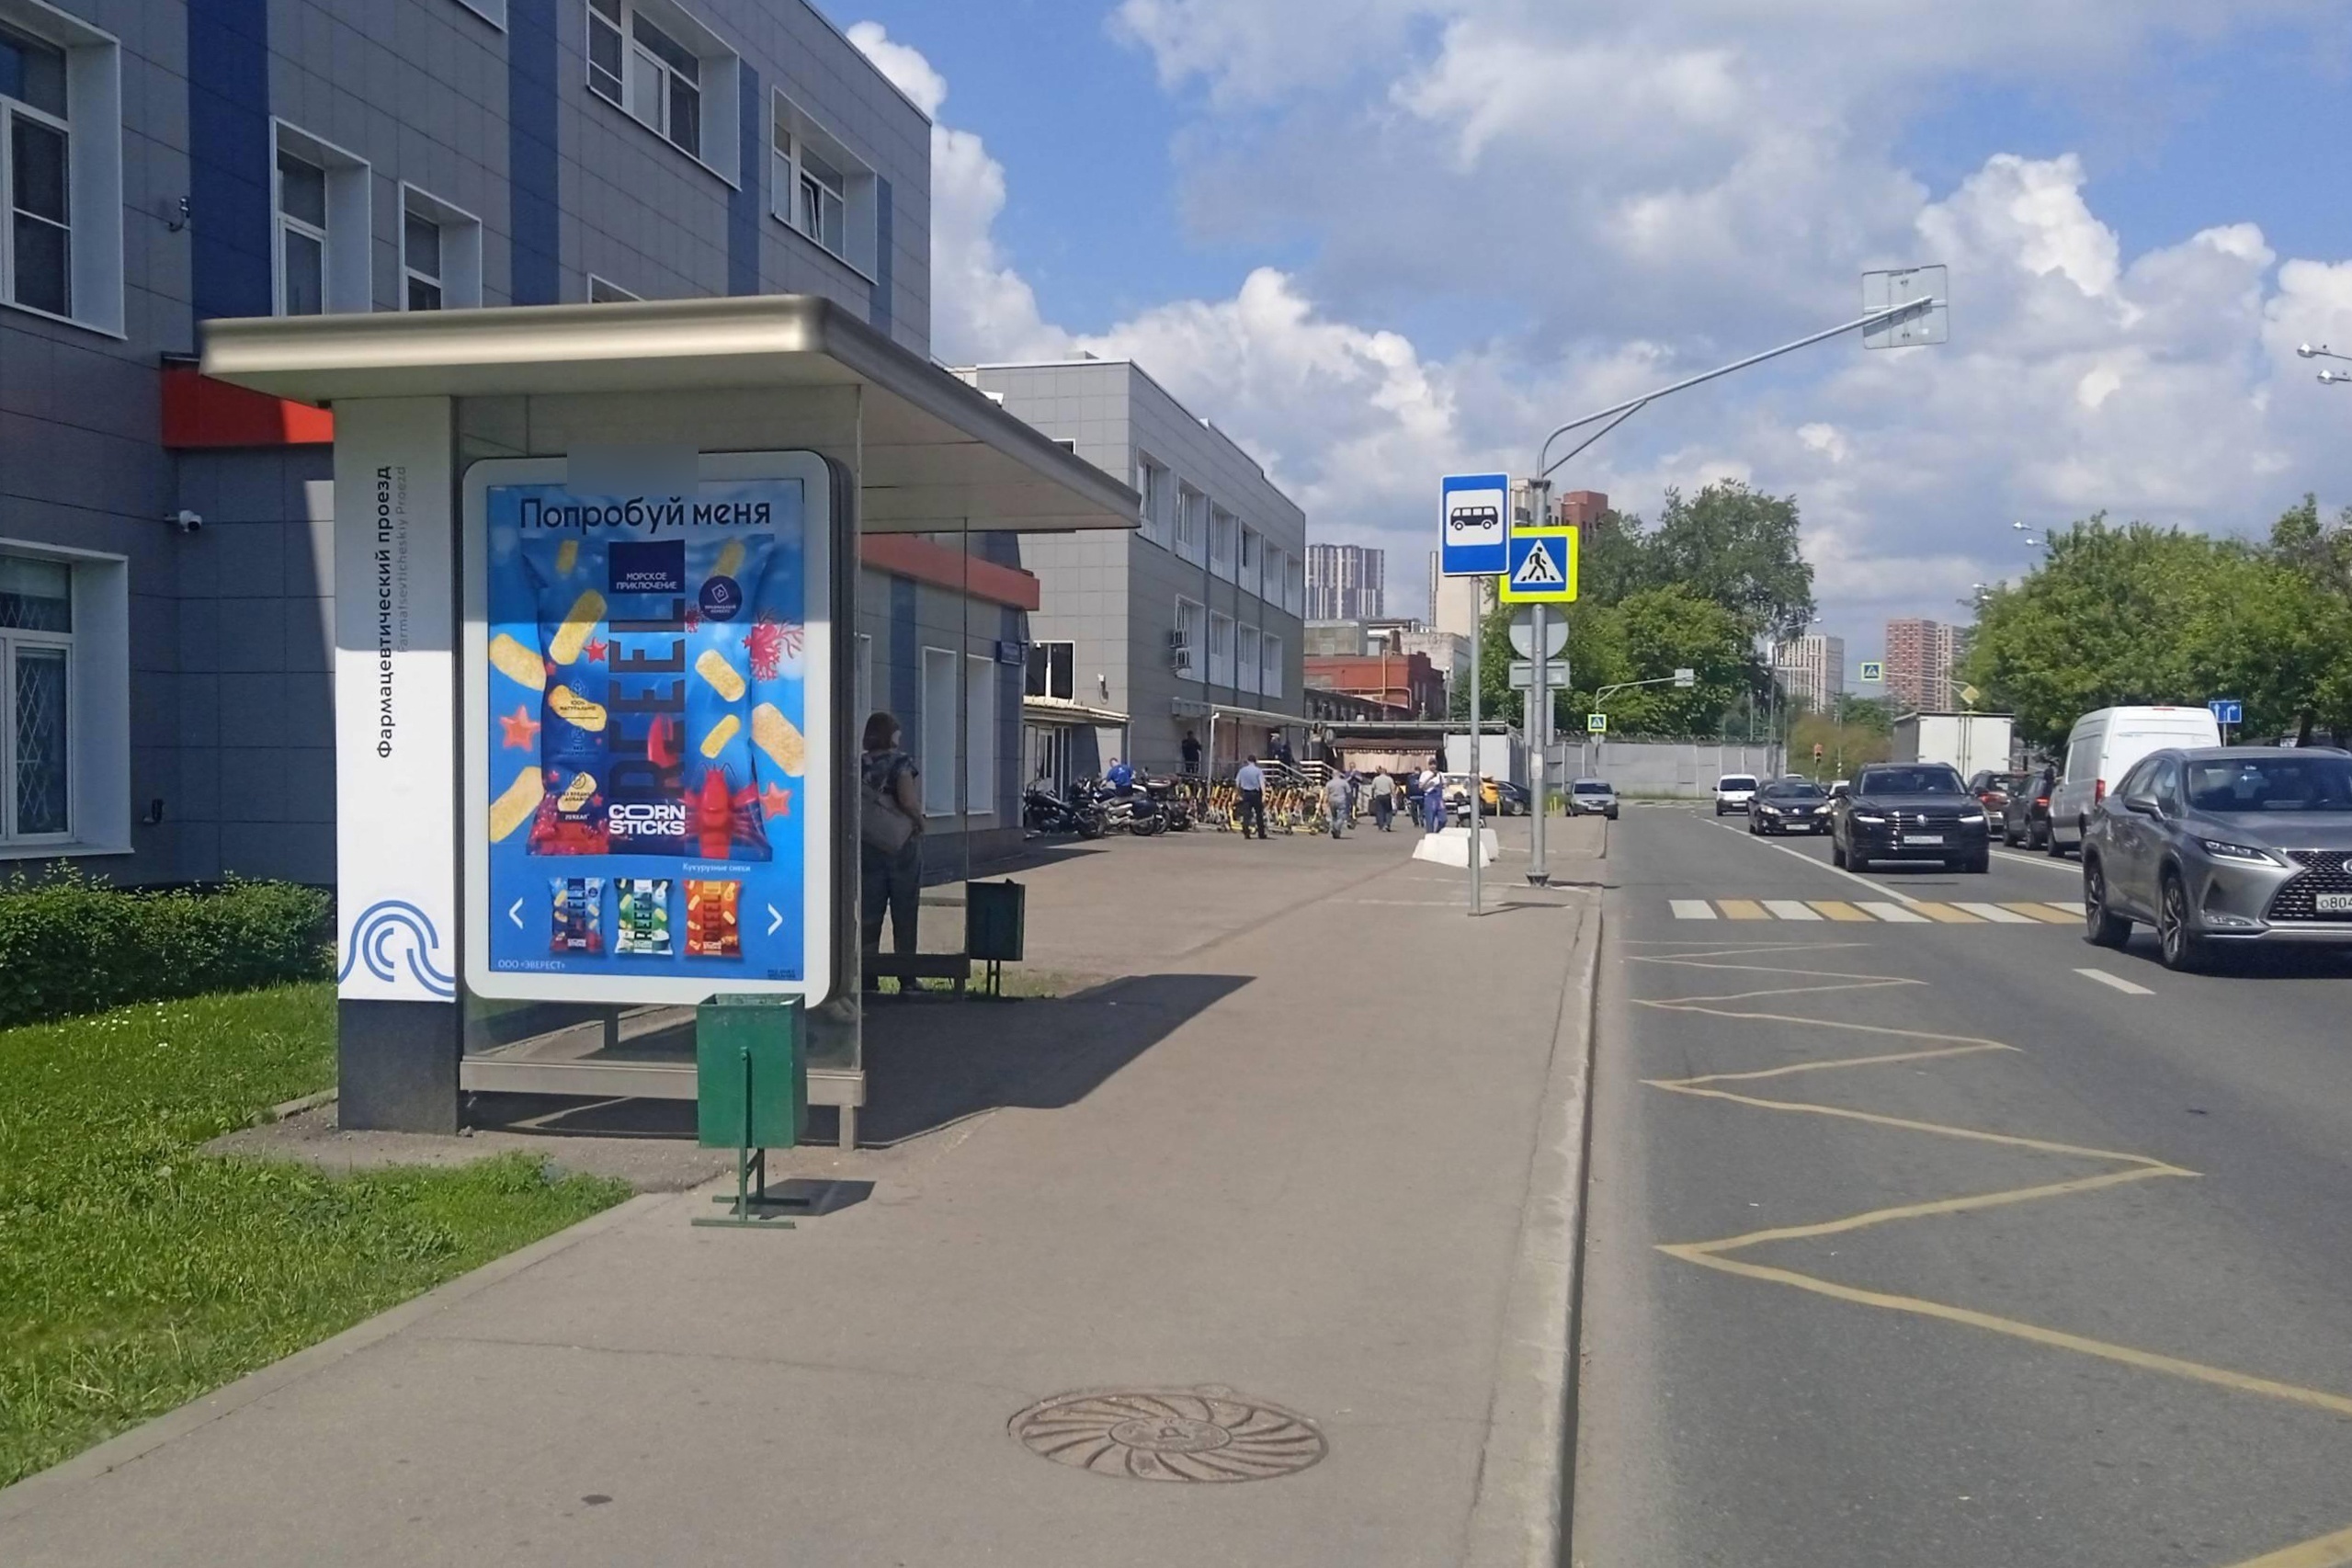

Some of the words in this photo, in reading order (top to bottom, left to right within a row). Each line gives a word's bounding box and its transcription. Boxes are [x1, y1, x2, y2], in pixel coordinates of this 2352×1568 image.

[377, 466, 393, 542] проезд
[520, 496, 684, 534] Попробуй
[693, 502, 770, 525] меня
[626, 572, 667, 581] МОРСКОЕ
[616, 581, 677, 590] ПРИКЛЮЧЕНИЕ
[375, 550, 395, 757] Фармацевтический
[608, 804, 686, 820] CORN
[608, 820, 686, 835] STICKS
